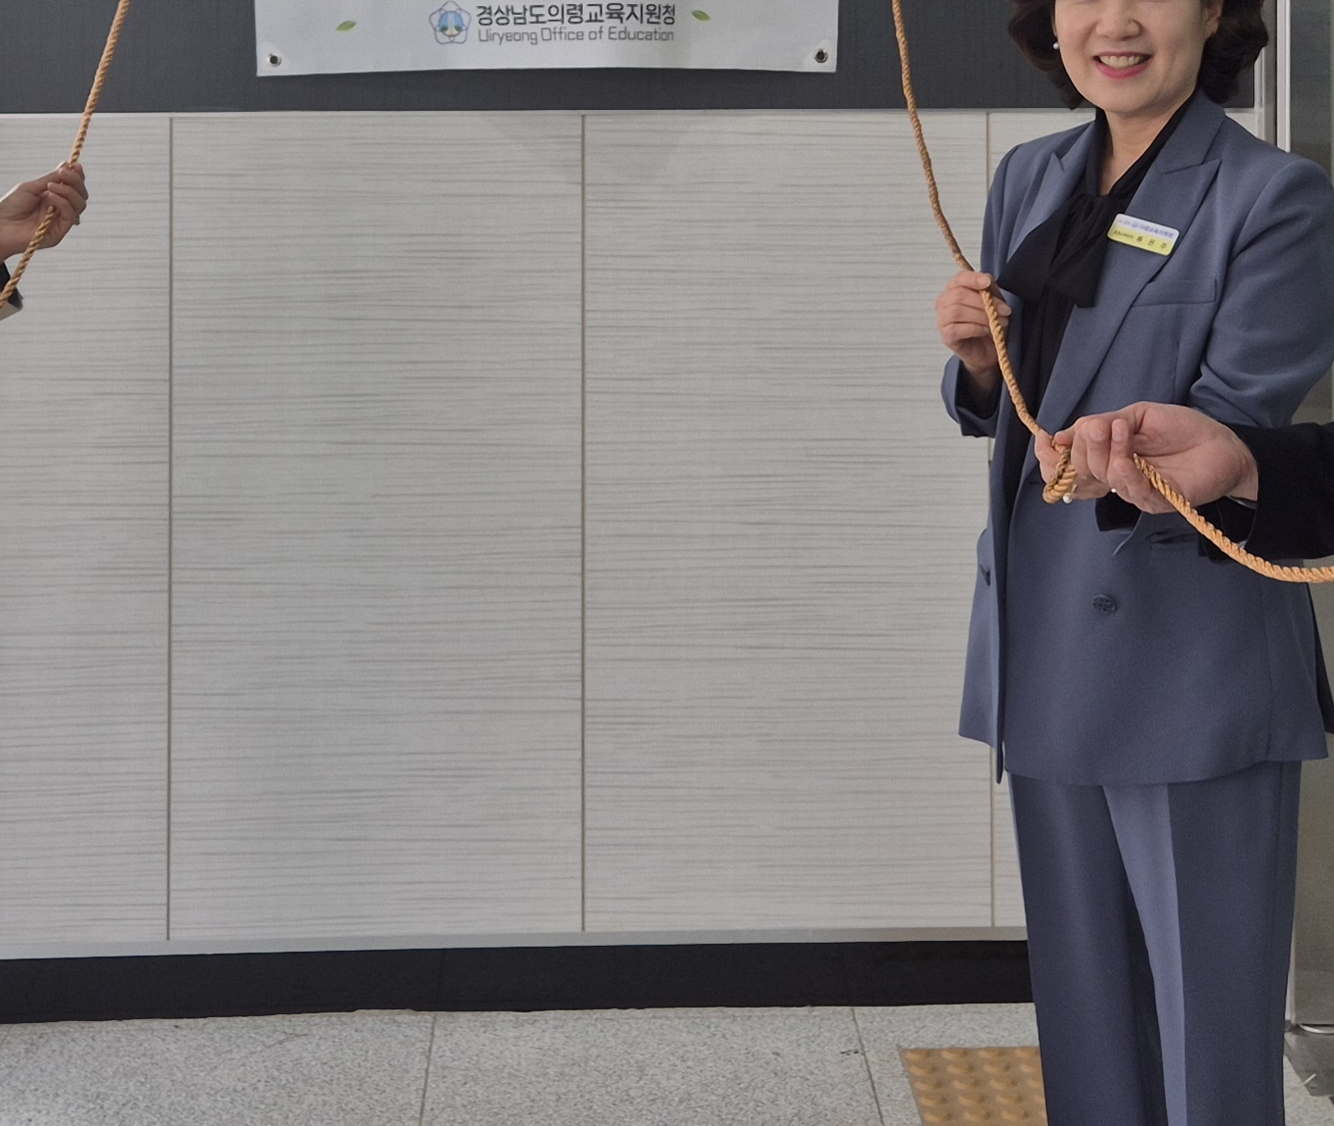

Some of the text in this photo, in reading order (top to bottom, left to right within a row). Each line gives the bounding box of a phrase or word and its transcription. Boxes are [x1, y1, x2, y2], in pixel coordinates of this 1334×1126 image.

[476, 2, 676, 26] 경상남도의령교육지원청
[478, 26, 675, 45] Uiryeong Office of Education
